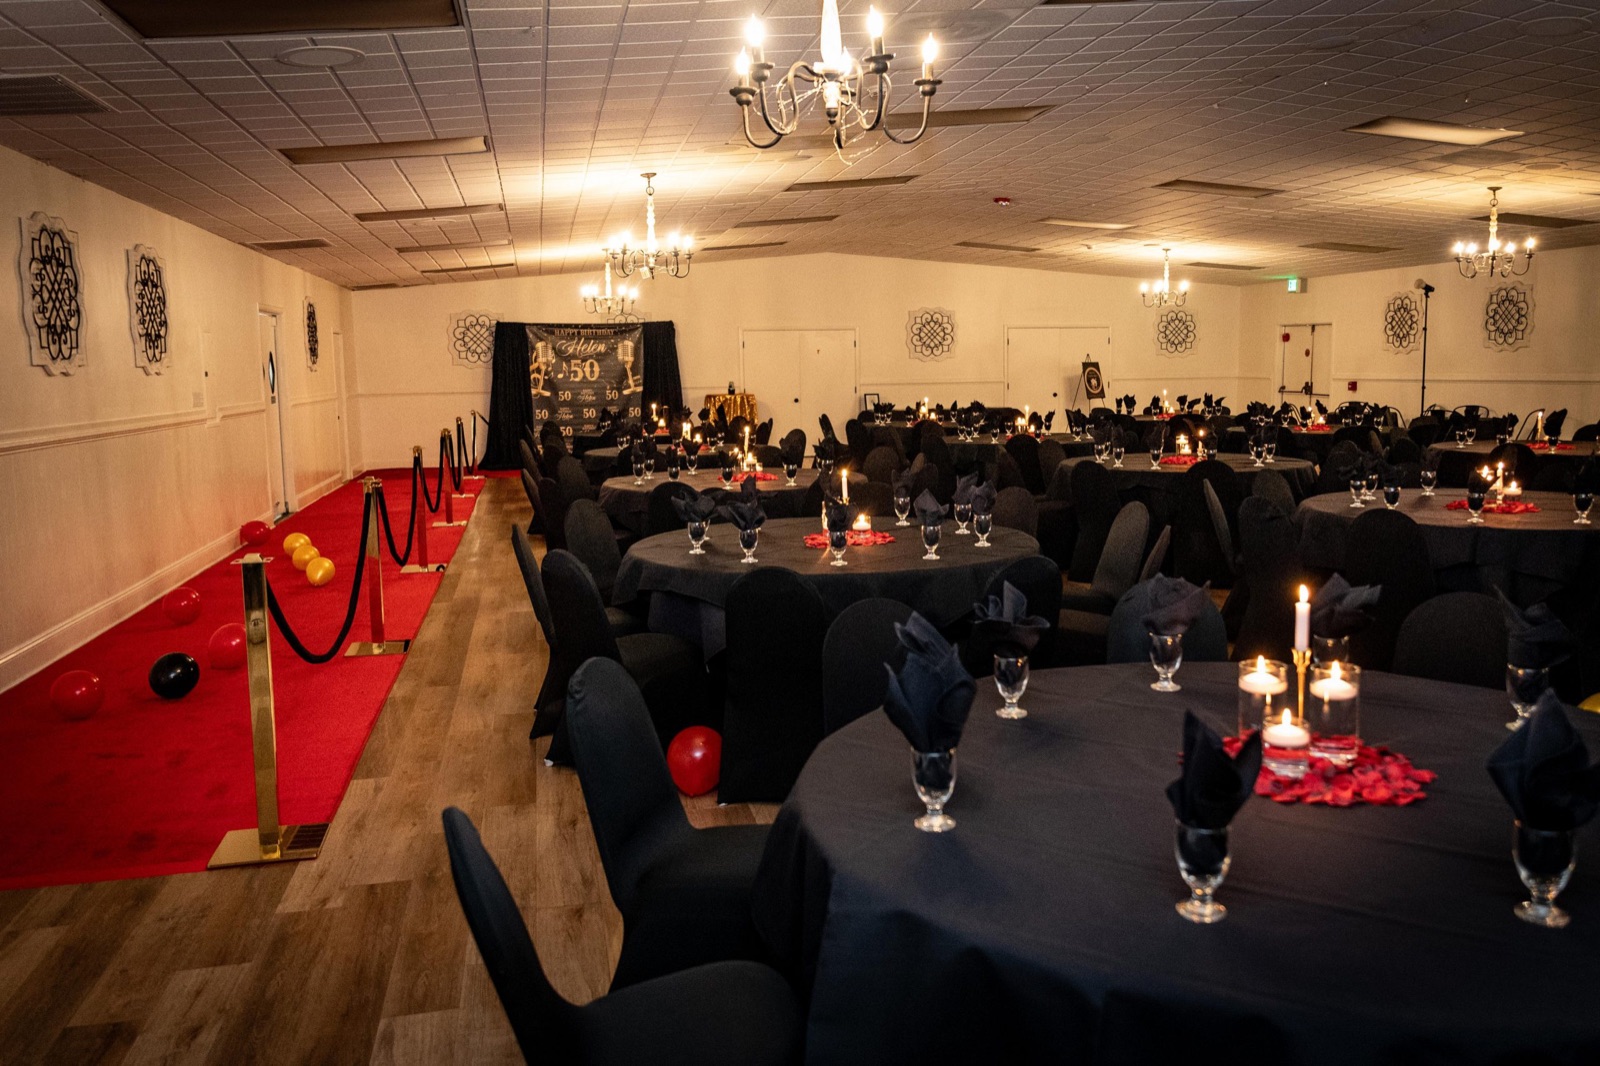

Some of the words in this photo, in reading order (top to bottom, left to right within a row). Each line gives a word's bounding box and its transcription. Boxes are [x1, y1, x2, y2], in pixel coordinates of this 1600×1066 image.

[556, 337, 606, 358] Helen
[570, 360, 600, 382] 50
[558, 391, 572, 401] 50
[606, 390, 618, 400] 50
[536, 410, 549, 420] 50
[583, 408, 596, 418] 50
[628, 408, 642, 417] 50
[560, 426, 573, 437] 50
